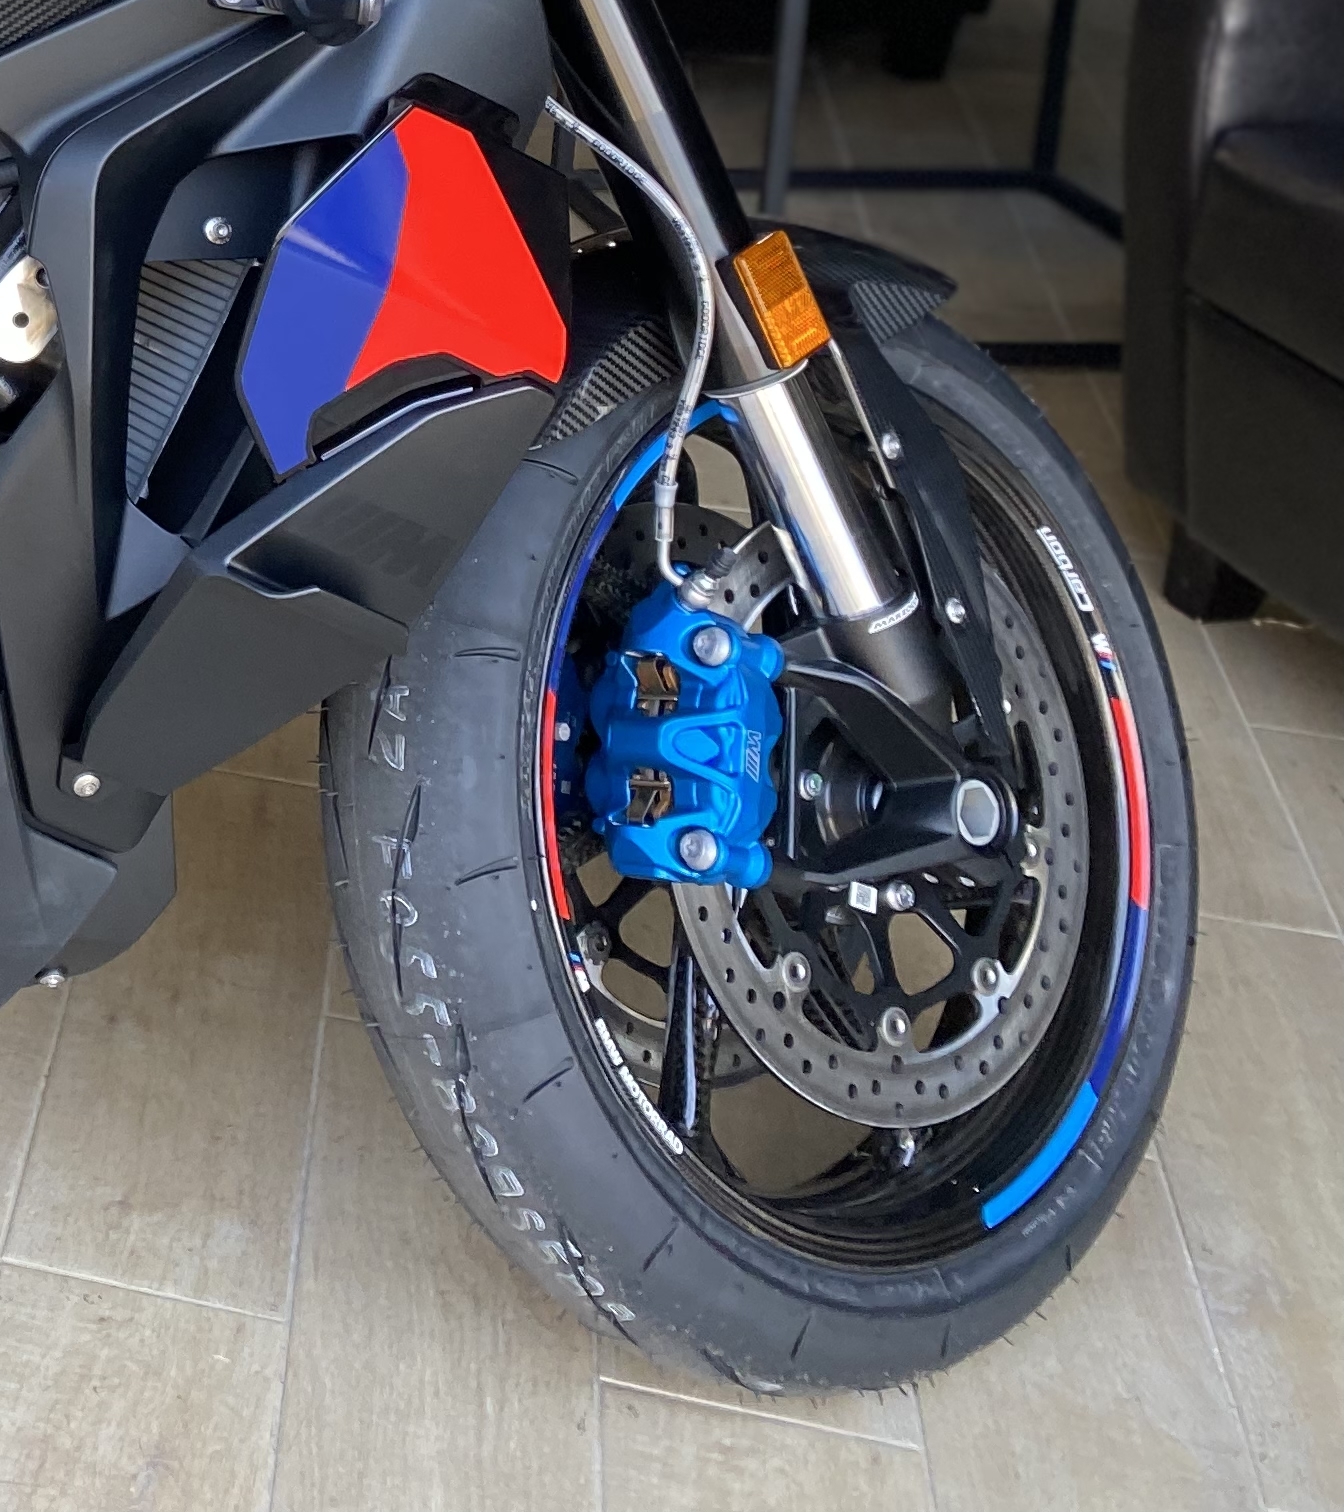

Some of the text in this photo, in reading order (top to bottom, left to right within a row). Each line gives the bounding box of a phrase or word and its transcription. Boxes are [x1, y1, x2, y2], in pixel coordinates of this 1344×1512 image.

[1035, 525, 1095, 612] Carbon
[595, 1017, 684, 1155] BMW MOTORRAD
